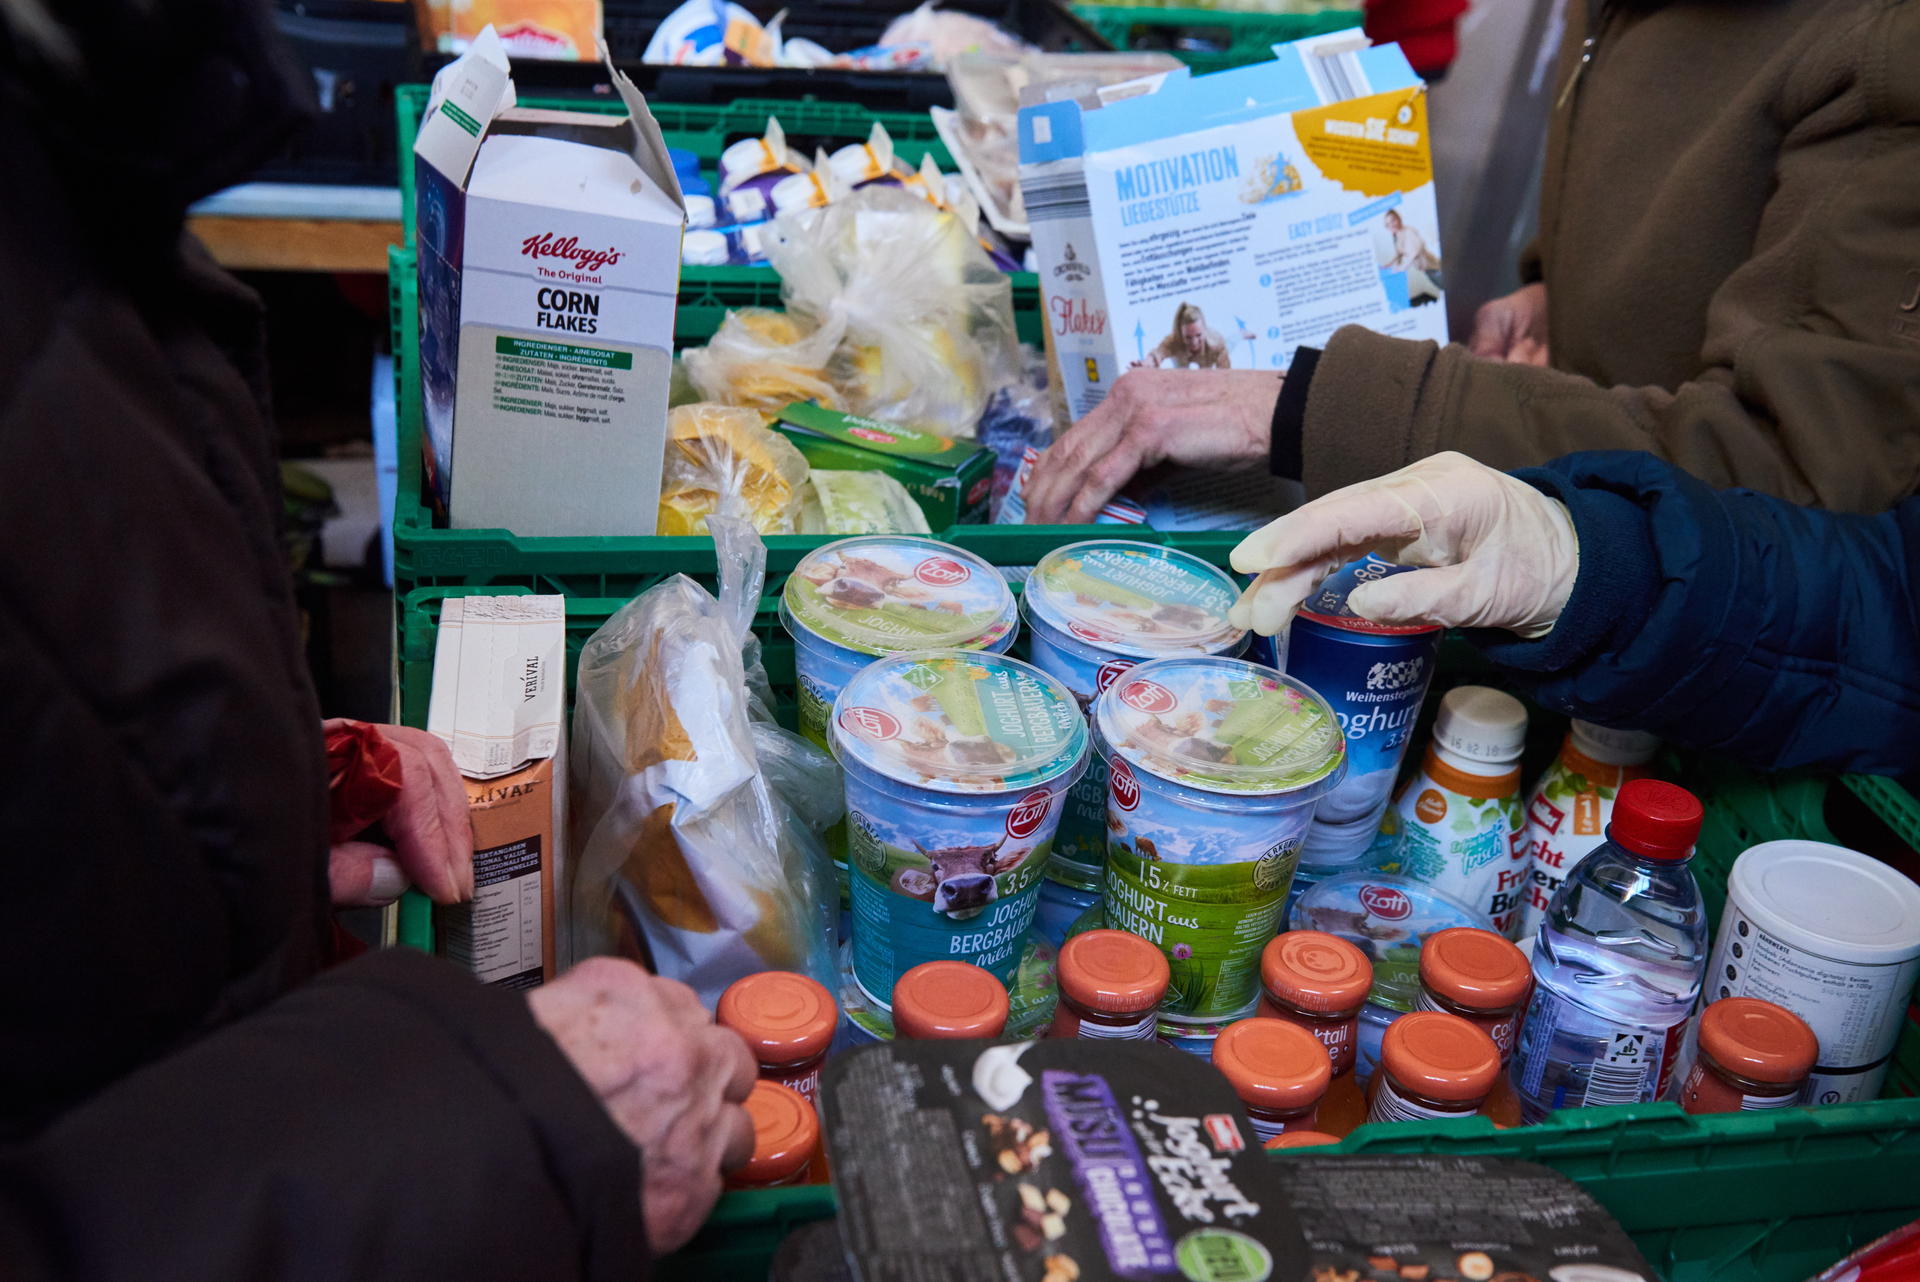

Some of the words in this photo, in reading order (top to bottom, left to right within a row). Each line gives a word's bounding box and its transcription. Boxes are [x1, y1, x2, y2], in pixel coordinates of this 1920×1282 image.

[1114, 144, 1240, 201] MOTIVATION
[521, 232, 621, 271] Kellogg's
[537, 267, 556, 278] The
[558, 270, 602, 285] Original
[537, 287, 600, 316] CORN
[537, 311, 598, 334] FLAKES
[520, 350, 554, 359] ZUTATEN
[920, 563, 964, 581] Zott
[1103, 568, 1175, 600] JOGHURT
[995, 670, 1009, 689] aus
[1126, 685, 1164, 708] Zott
[992, 691, 1026, 737] JOGHURT
[1336, 701, 1420, 740] oghurt
[1112, 769, 1137, 799] Zott
[1013, 798, 1049, 827] Zott
[1463, 834, 1502, 875] frisch
[1531, 839, 1566, 869] cht
[1173, 885, 1198, 899] FETT
[1497, 869, 1530, 892] Fru
[1107, 865, 1168, 922] JOGHURT
[1167, 914, 1199, 929] aus
[1365, 893, 1409, 912] Zott
[976, 943, 1013, 967] Milch
[1149, 1112, 1260, 1217] Joghurt
[1148, 1156, 1215, 1222] Ecke
